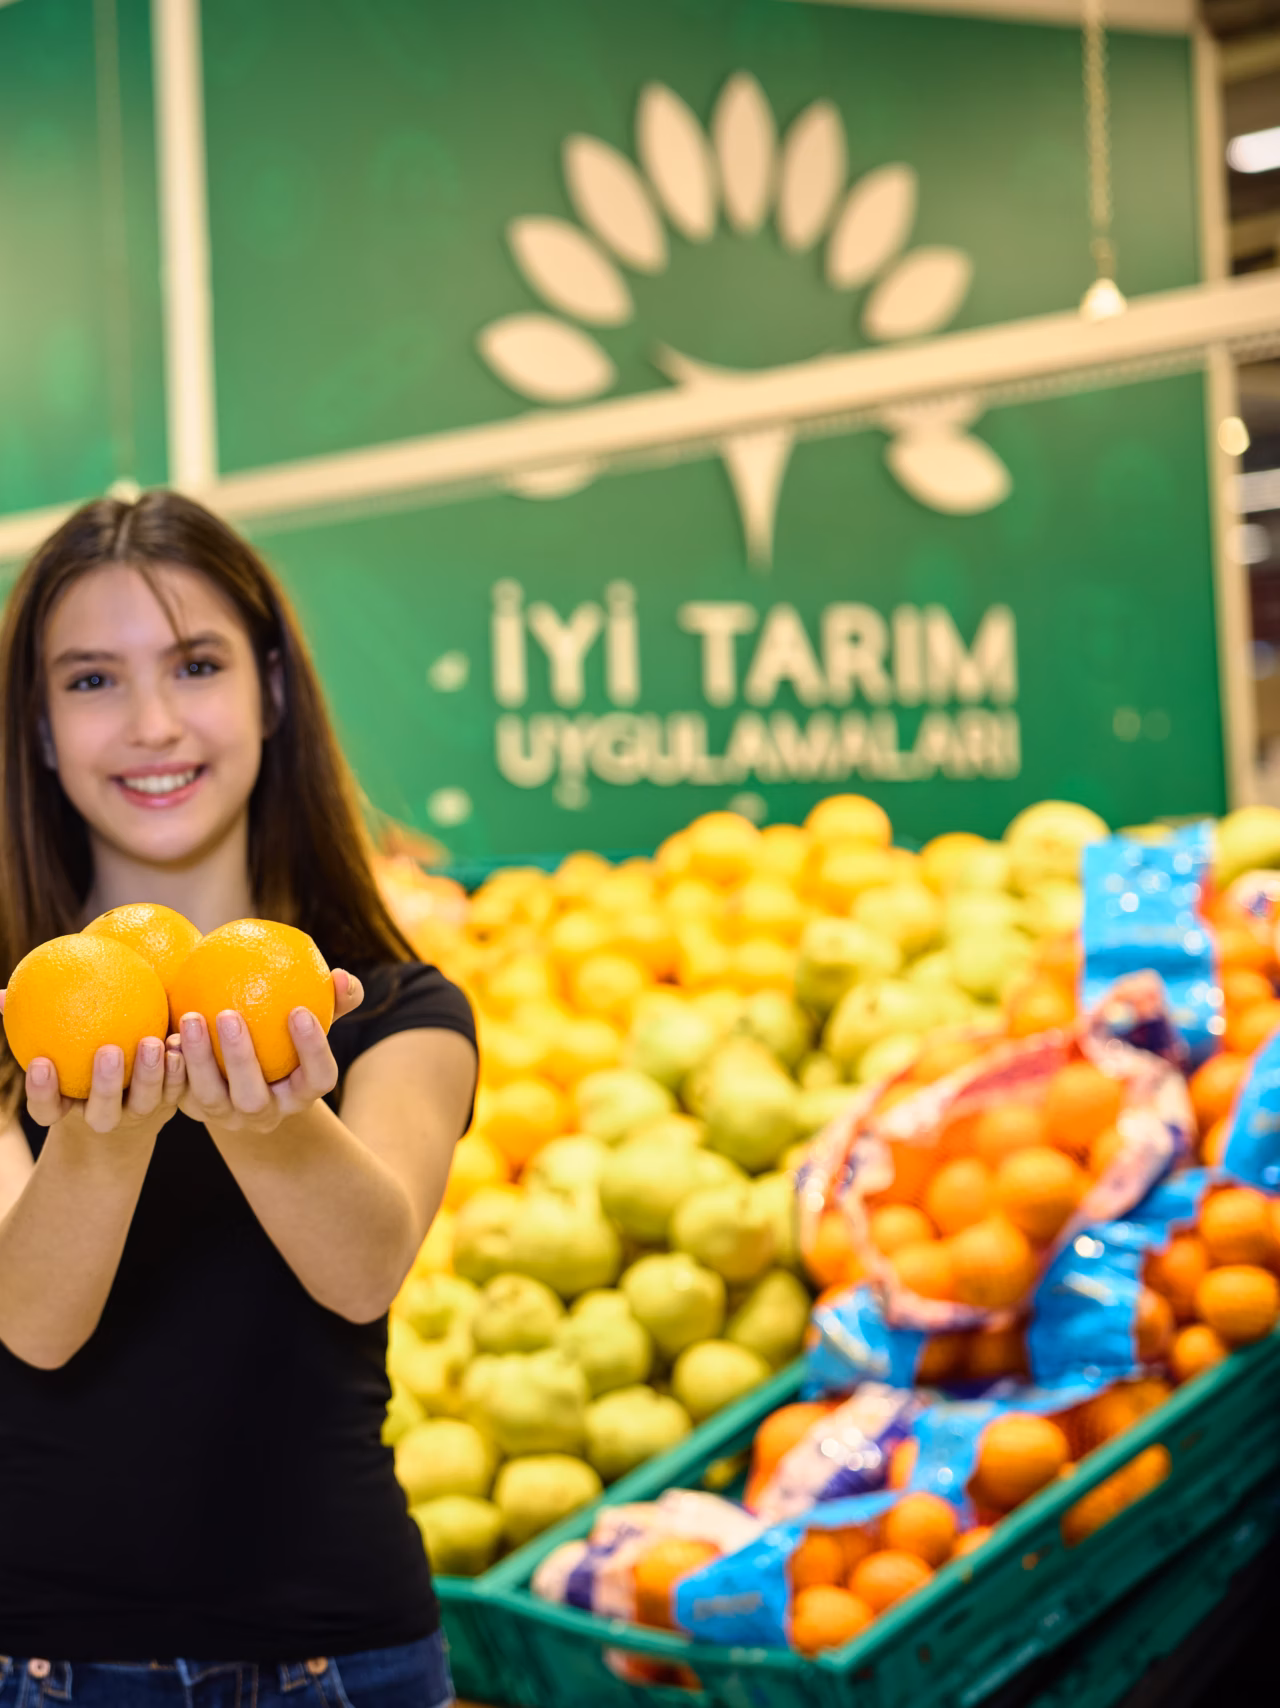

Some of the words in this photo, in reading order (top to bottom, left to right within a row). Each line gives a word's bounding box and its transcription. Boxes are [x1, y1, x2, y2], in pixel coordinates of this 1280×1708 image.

[492, 577, 641, 707] İYİ
[678, 601, 1017, 707] TARIM
[496, 709, 1020, 787] UYGULAMALARI
